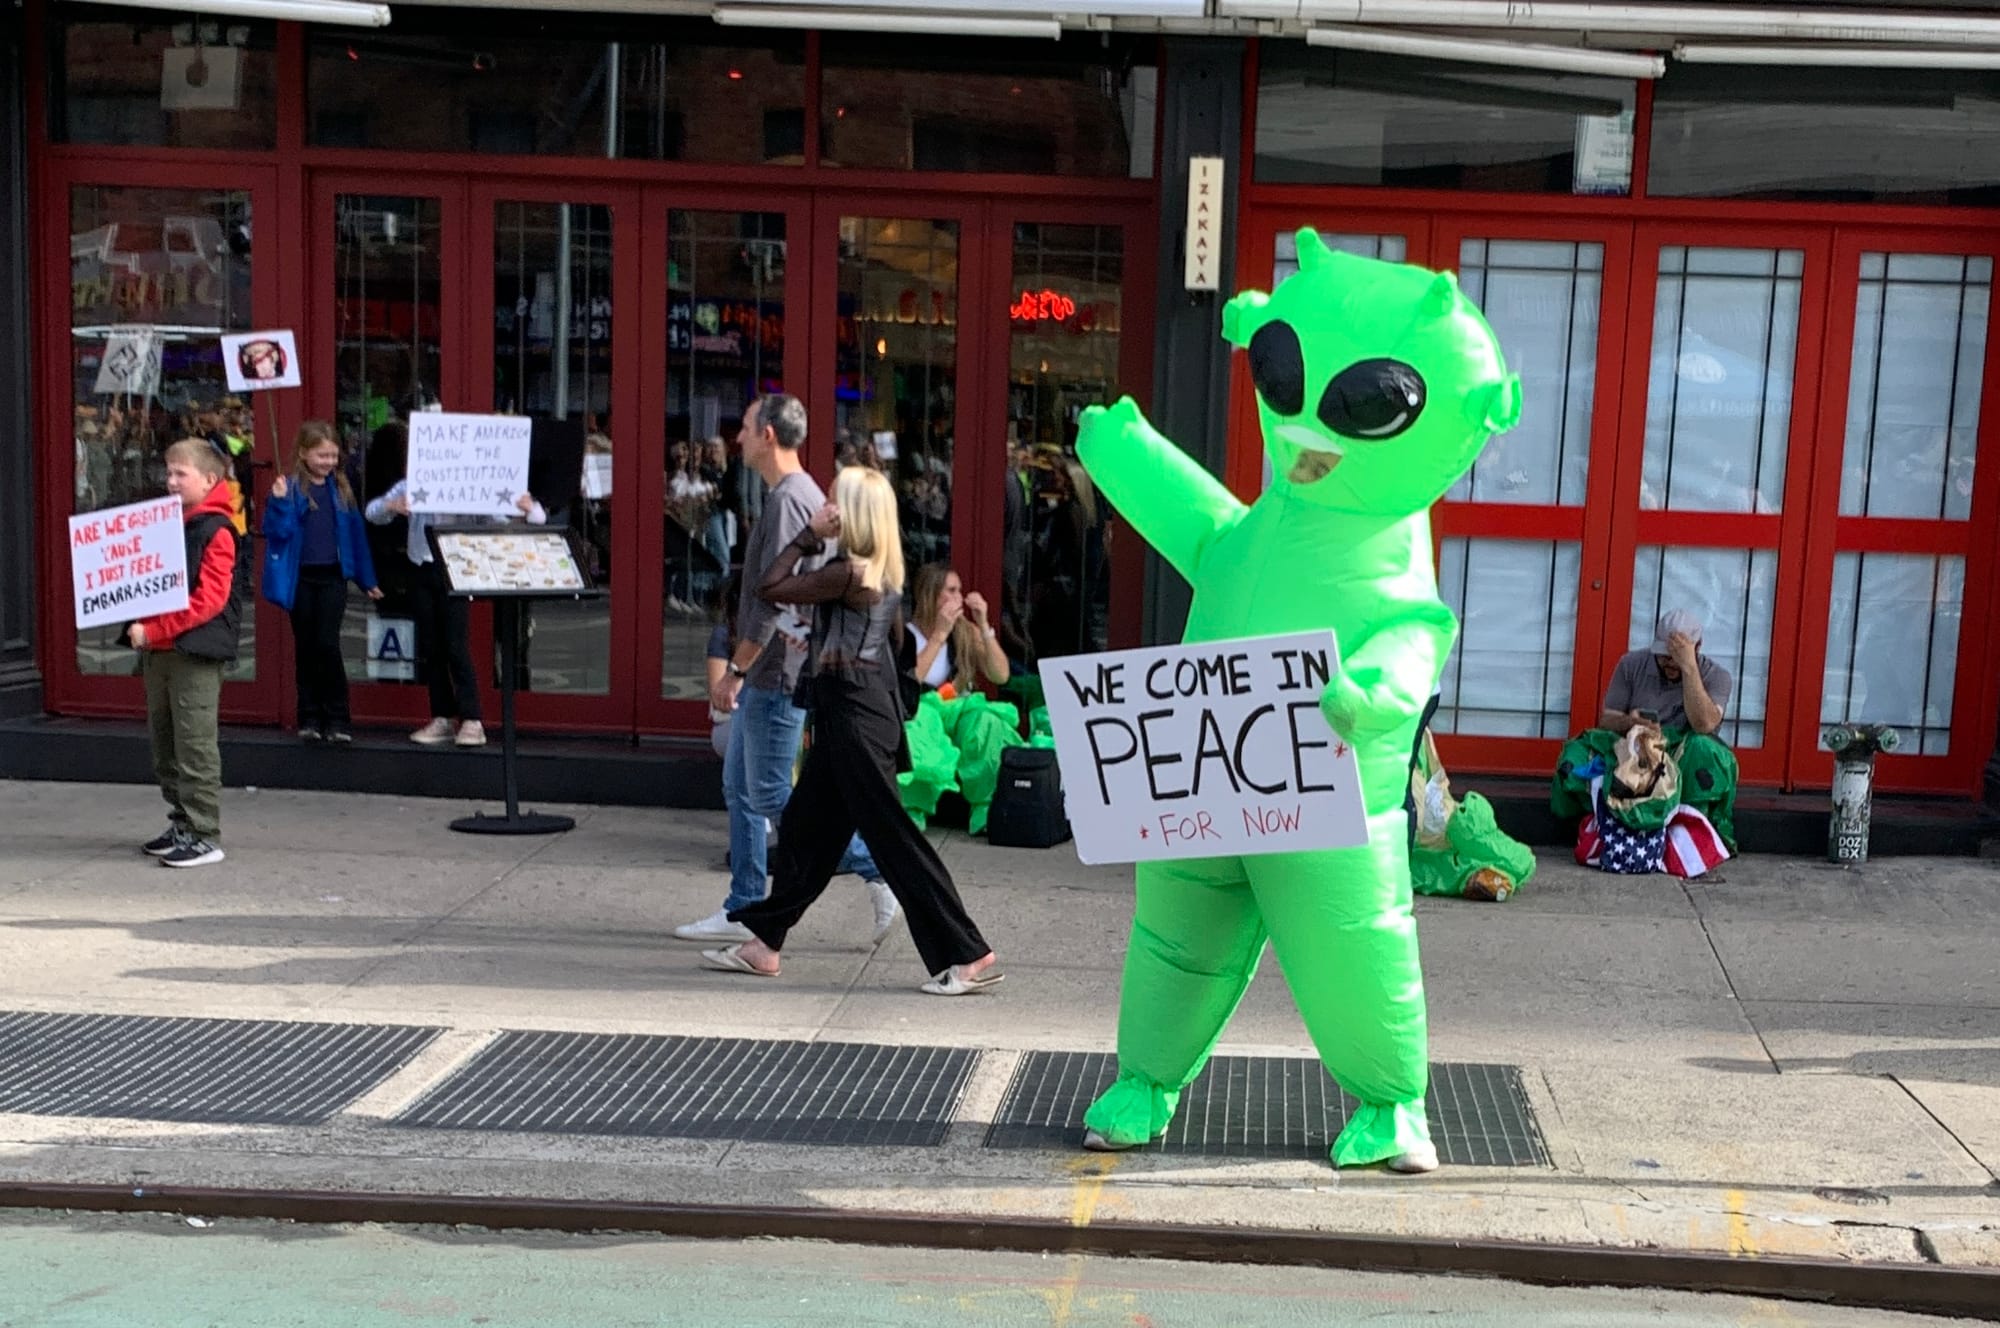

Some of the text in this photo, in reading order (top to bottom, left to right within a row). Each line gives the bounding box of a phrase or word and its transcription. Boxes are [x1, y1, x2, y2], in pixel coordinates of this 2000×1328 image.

[1194, 165, 1209, 284] IZAKAYA
[416, 424, 468, 443] MAKE
[417, 445, 502, 462] FOLLOW THE
[415, 465, 521, 484] CONSTITUTION
[436, 485, 492, 503] AGAIN
[73, 522, 101, 548] ARE
[104, 514, 126, 536] WE
[84, 552, 164, 592] I JUST FEEL
[378, 627, 405, 660] A
[1064, 649, 1330, 707] WE COME IN
[1242, 804, 1301, 838] NOW
[1838, 836, 1861, 848] DOZ
[1838, 848, 1860, 859] BX
